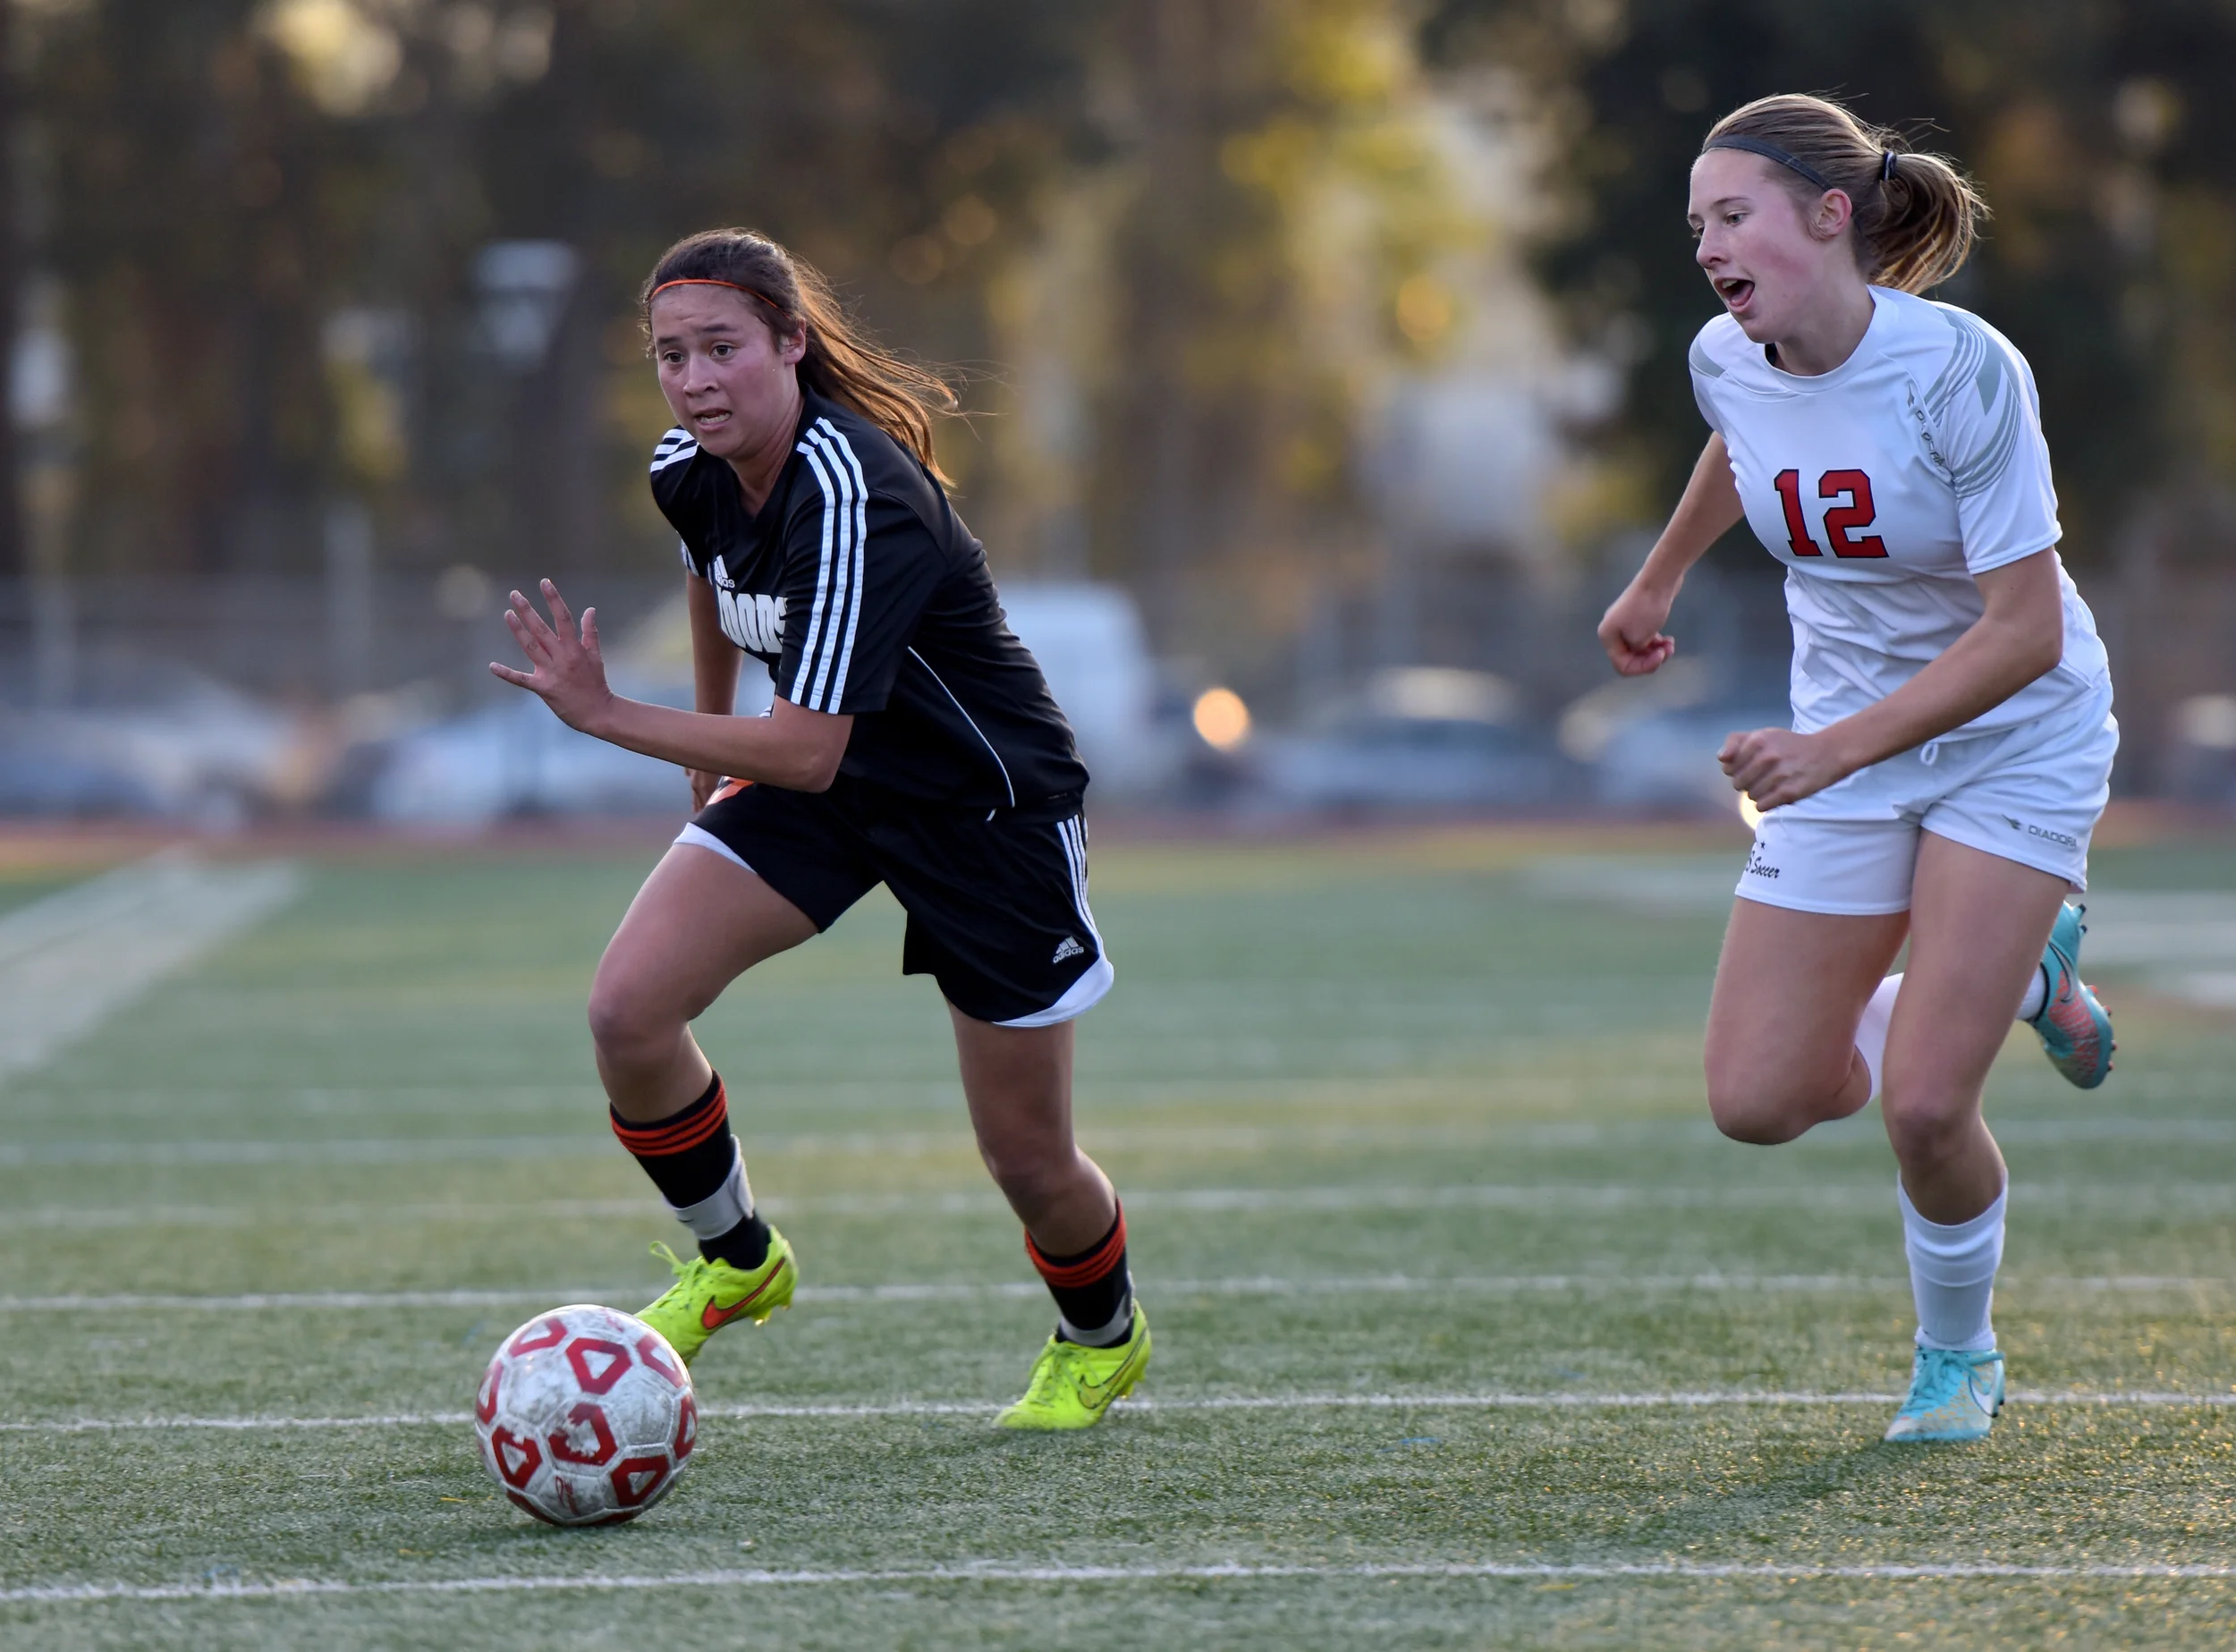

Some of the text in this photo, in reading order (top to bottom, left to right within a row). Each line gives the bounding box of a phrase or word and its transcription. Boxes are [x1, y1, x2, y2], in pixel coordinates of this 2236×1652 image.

[1774, 469, 1890, 558] 12
[2028, 824, 2078, 849] DIADORA
[1749, 855, 1781, 879] Soccer
[1052, 946, 1085, 964] adidas
